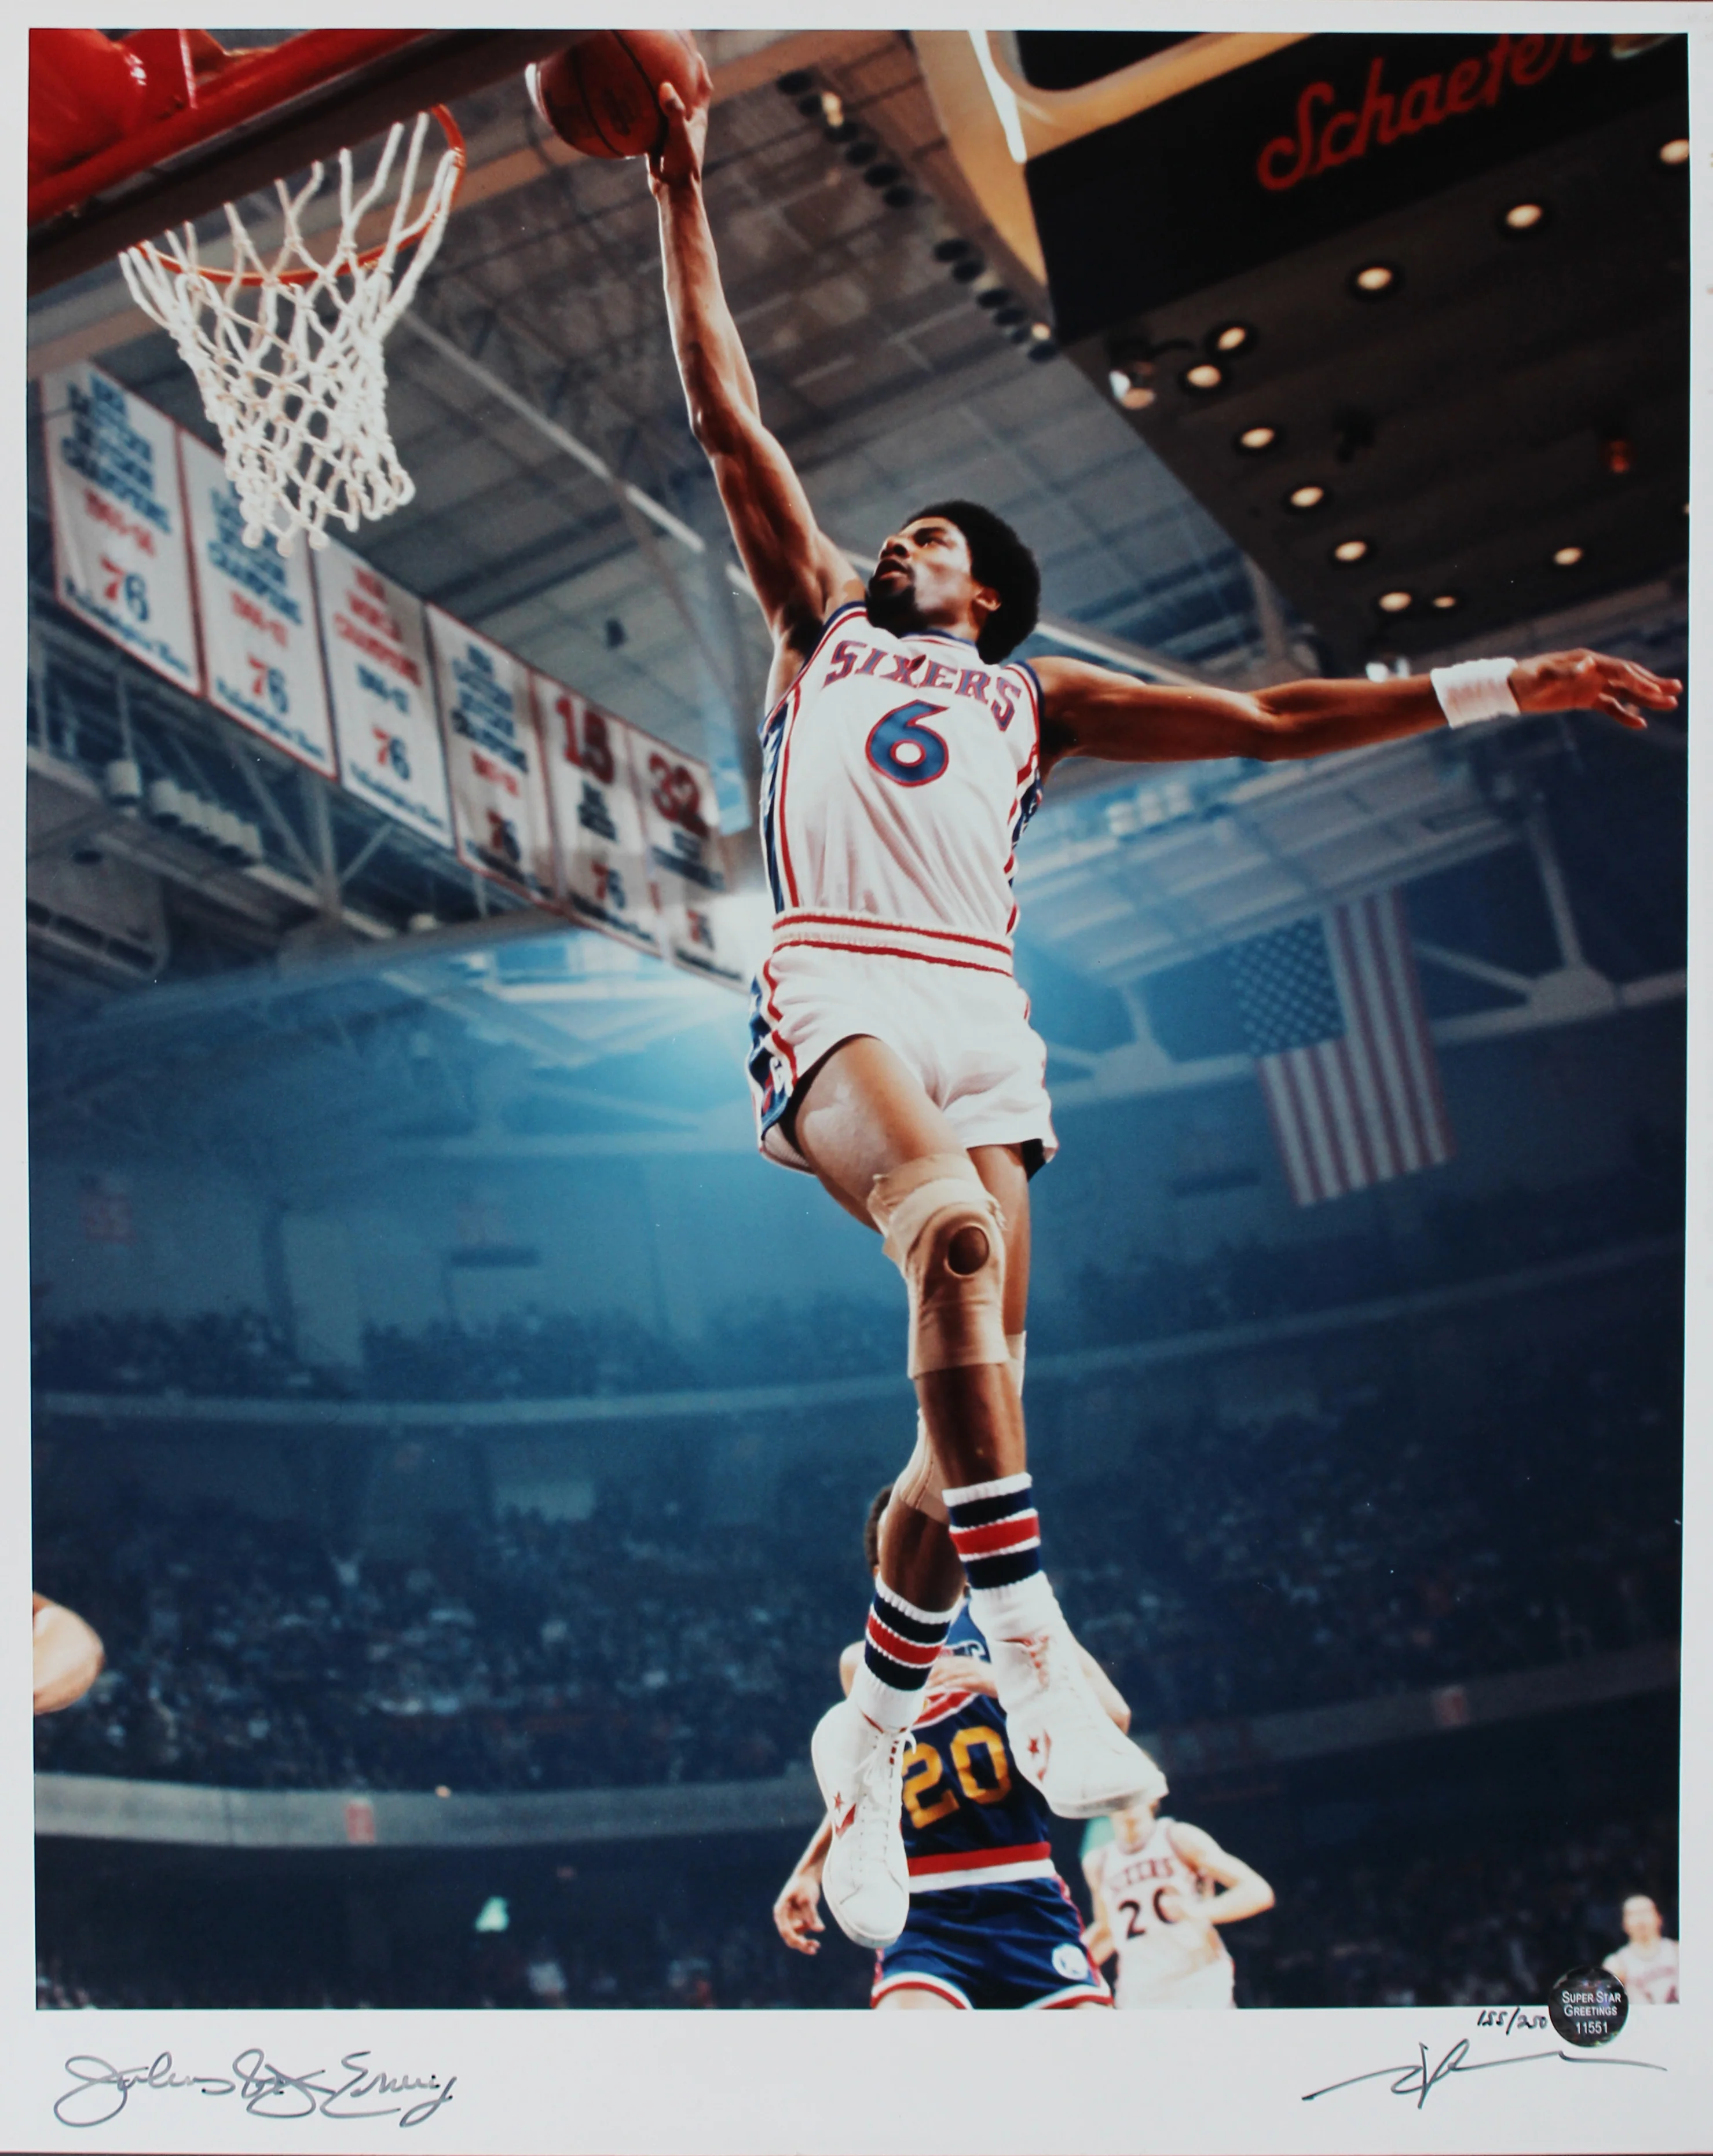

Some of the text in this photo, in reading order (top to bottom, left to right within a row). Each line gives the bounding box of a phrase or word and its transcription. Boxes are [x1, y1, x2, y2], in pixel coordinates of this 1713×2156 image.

[820, 640, 1022, 732] SIXERS
[865, 699, 950, 788] 6
[902, 1725, 1012, 1829] 20
[1564, 2004, 1617, 2017] GREETINGS
[1576, 2020, 1608, 2034] 11551
